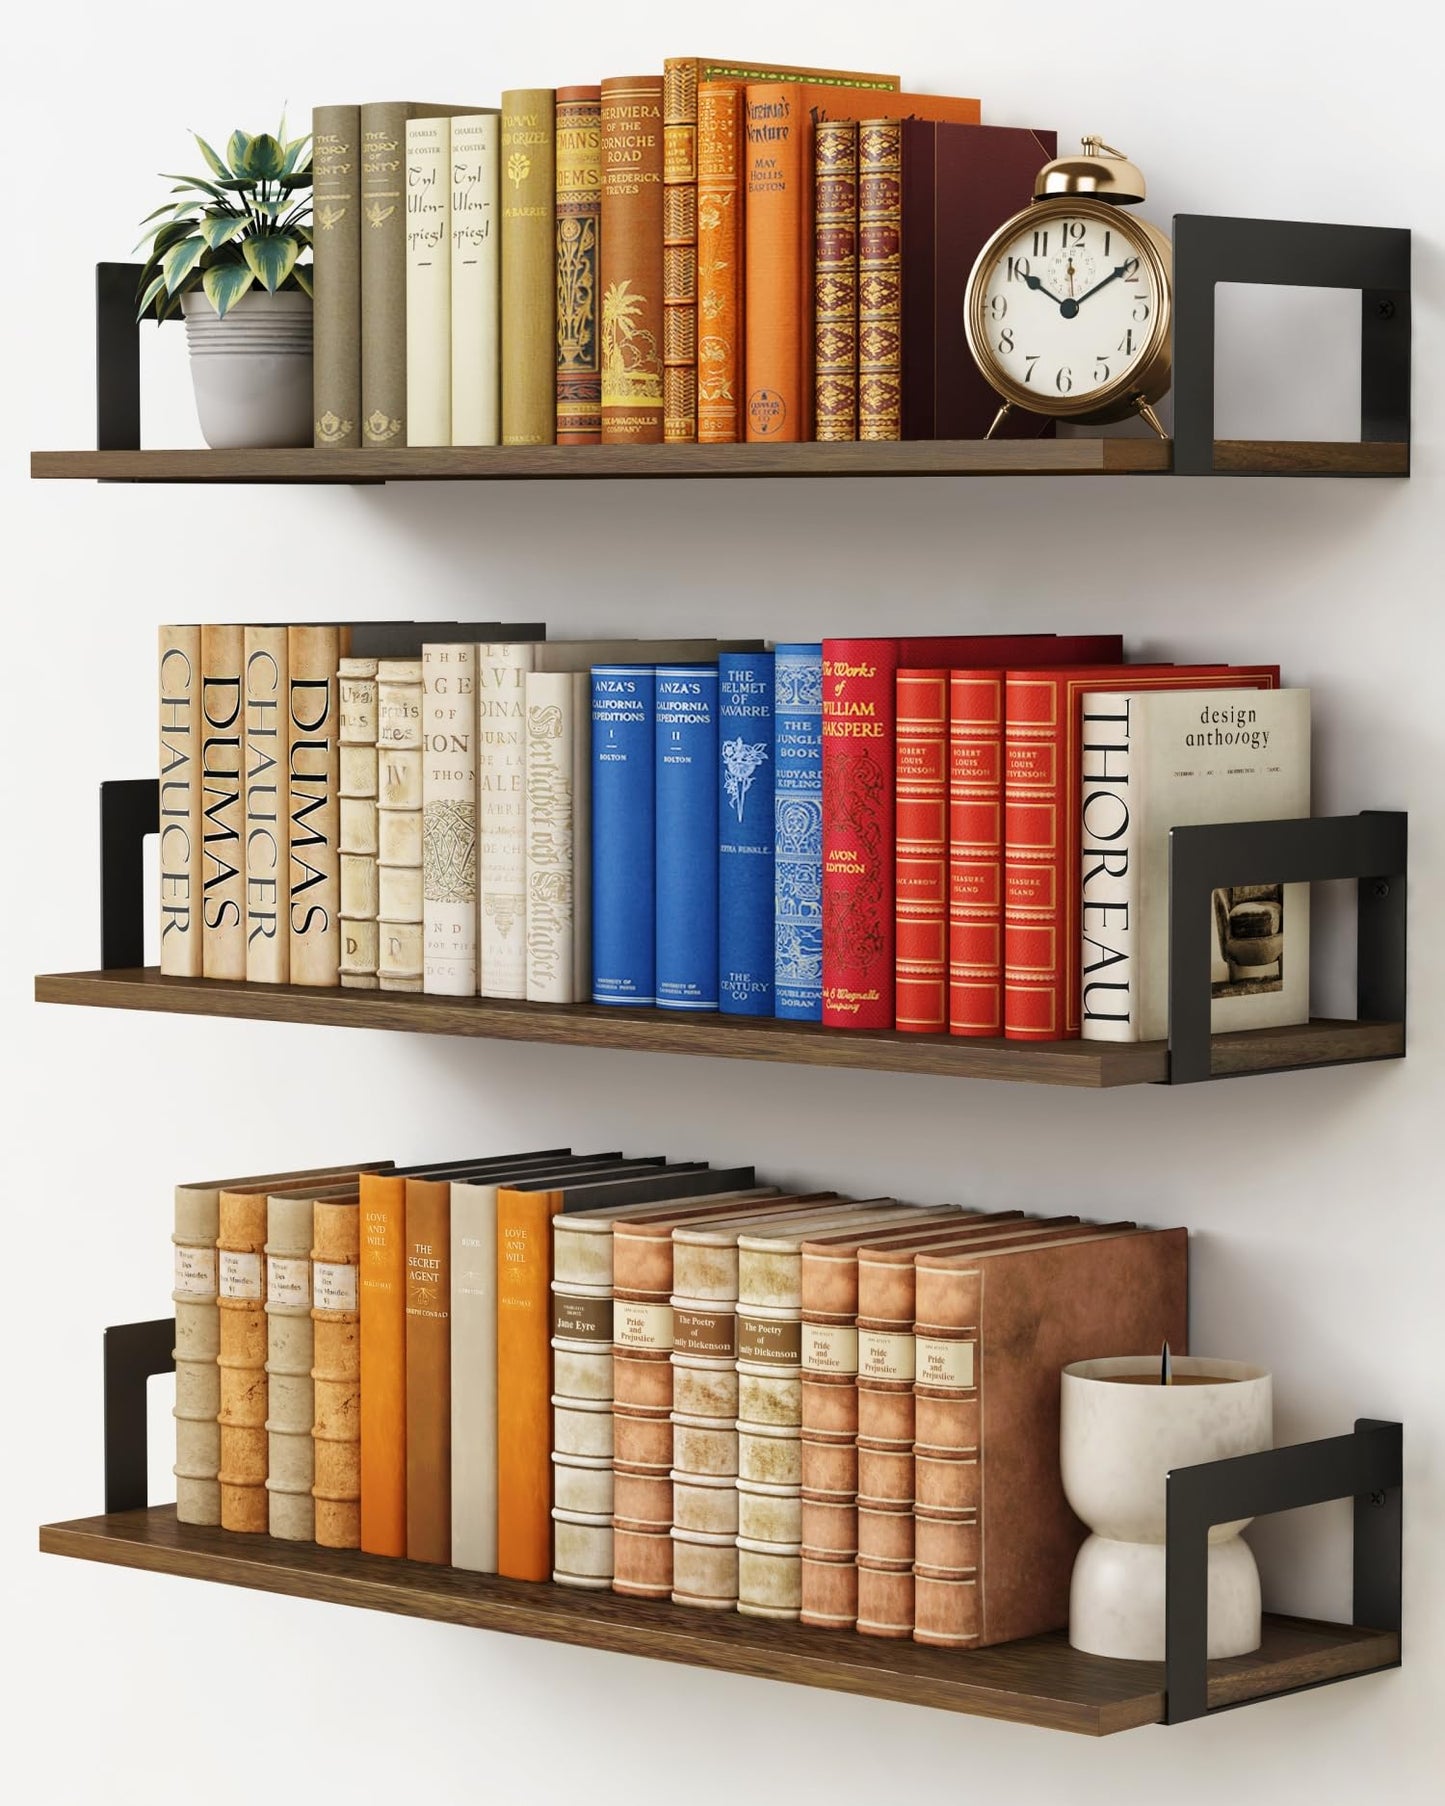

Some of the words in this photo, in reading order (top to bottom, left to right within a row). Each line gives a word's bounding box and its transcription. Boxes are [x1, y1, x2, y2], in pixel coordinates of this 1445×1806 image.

[610, 106, 660, 119] RIVIERA
[606, 123, 617, 132] OF
[620, 122, 642, 131] THE
[415, 147, 441, 155] COSTER
[459, 144, 486, 153] COSTER
[608, 150, 642, 163] ROAD
[754, 158, 776, 168] MAY
[608, 173, 660, 184] FREDERICK
[750, 170, 783, 182] HOLLIS
[606, 185, 640, 196] TREVES
[748, 182, 786, 194] BARTON
[1063, 222, 1086, 248] 12
[1034, 231, 1048, 257] 11
[1104, 230, 1111, 256] 1
[1008, 256, 1030, 282] 10
[1125, 256, 1140, 282] 2
[992, 295, 1008, 321] 9
[998, 327, 1014, 354] 8
[1118, 329, 1137, 356] 4
[1024, 356, 1041, 383] 7
[1094, 356, 1110, 382] 5
[1056, 366, 1072, 392] 6
[424, 652, 468, 662] THE
[728, 670, 755, 682] THE
[834, 662, 876, 678] Works
[595, 681, 636, 693] ANZA'S
[659, 683, 700, 694] ANZA'S
[722, 682, 767, 694] HELMET
[834, 680, 846, 697] of
[732, 694, 748, 705] OF
[434, 708, 456, 720] OF
[720, 706, 770, 718] NAVARRE
[1200, 706, 1257, 728] design
[784, 721, 812, 731] THE
[672, 731, 680, 740] II
[780, 748, 820, 758] BOOK
[778, 779, 822, 789] KIPLING
[161, 648, 192, 946] CHAUCER
[203, 675, 241, 928] DUMAS
[248, 650, 278, 952] CHAUCER
[290, 676, 329, 935] DUMAS
[829, 850, 857, 862] AVON
[1082, 696, 1132, 1025] THOREAU
[826, 862, 866, 874] EDITION
[346, 937, 358, 954] D
[730, 972, 752, 982] THE
[721, 982, 770, 992] CENTURY
[732, 992, 748, 1001] CO
[781, 998, 814, 1008] DORAN
[366, 1212, 388, 1224] LOVE
[367, 1225, 386, 1235] AND
[505, 1228, 527, 1240] LOVE
[366, 1237, 387, 1248] WILL
[506, 1242, 525, 1252] AND
[414, 1244, 433, 1255] THE
[408, 1256, 441, 1270] SECRET
[505, 1253, 526, 1264] WILL
[409, 1270, 440, 1282] AGENT
[557, 1318, 574, 1329] Jane
[576, 1320, 596, 1332] Eyre
[626, 1317, 645, 1328] Pride
[678, 1316, 691, 1326] The
[692, 1317, 716, 1328] Poetry
[744, 1322, 756, 1332] The
[758, 1324, 782, 1336] Poetry
[688, 1339, 732, 1352] Dickenson
[756, 1336, 764, 1344] of
[814, 1340, 831, 1350] Pride
[754, 1347, 798, 1360] Dickenson
[816, 1350, 828, 1358] and
[870, 1348, 887, 1358] Pride
[928, 1354, 946, 1364] Pride
[872, 1357, 885, 1365] and
[930, 1364, 942, 1372] and
